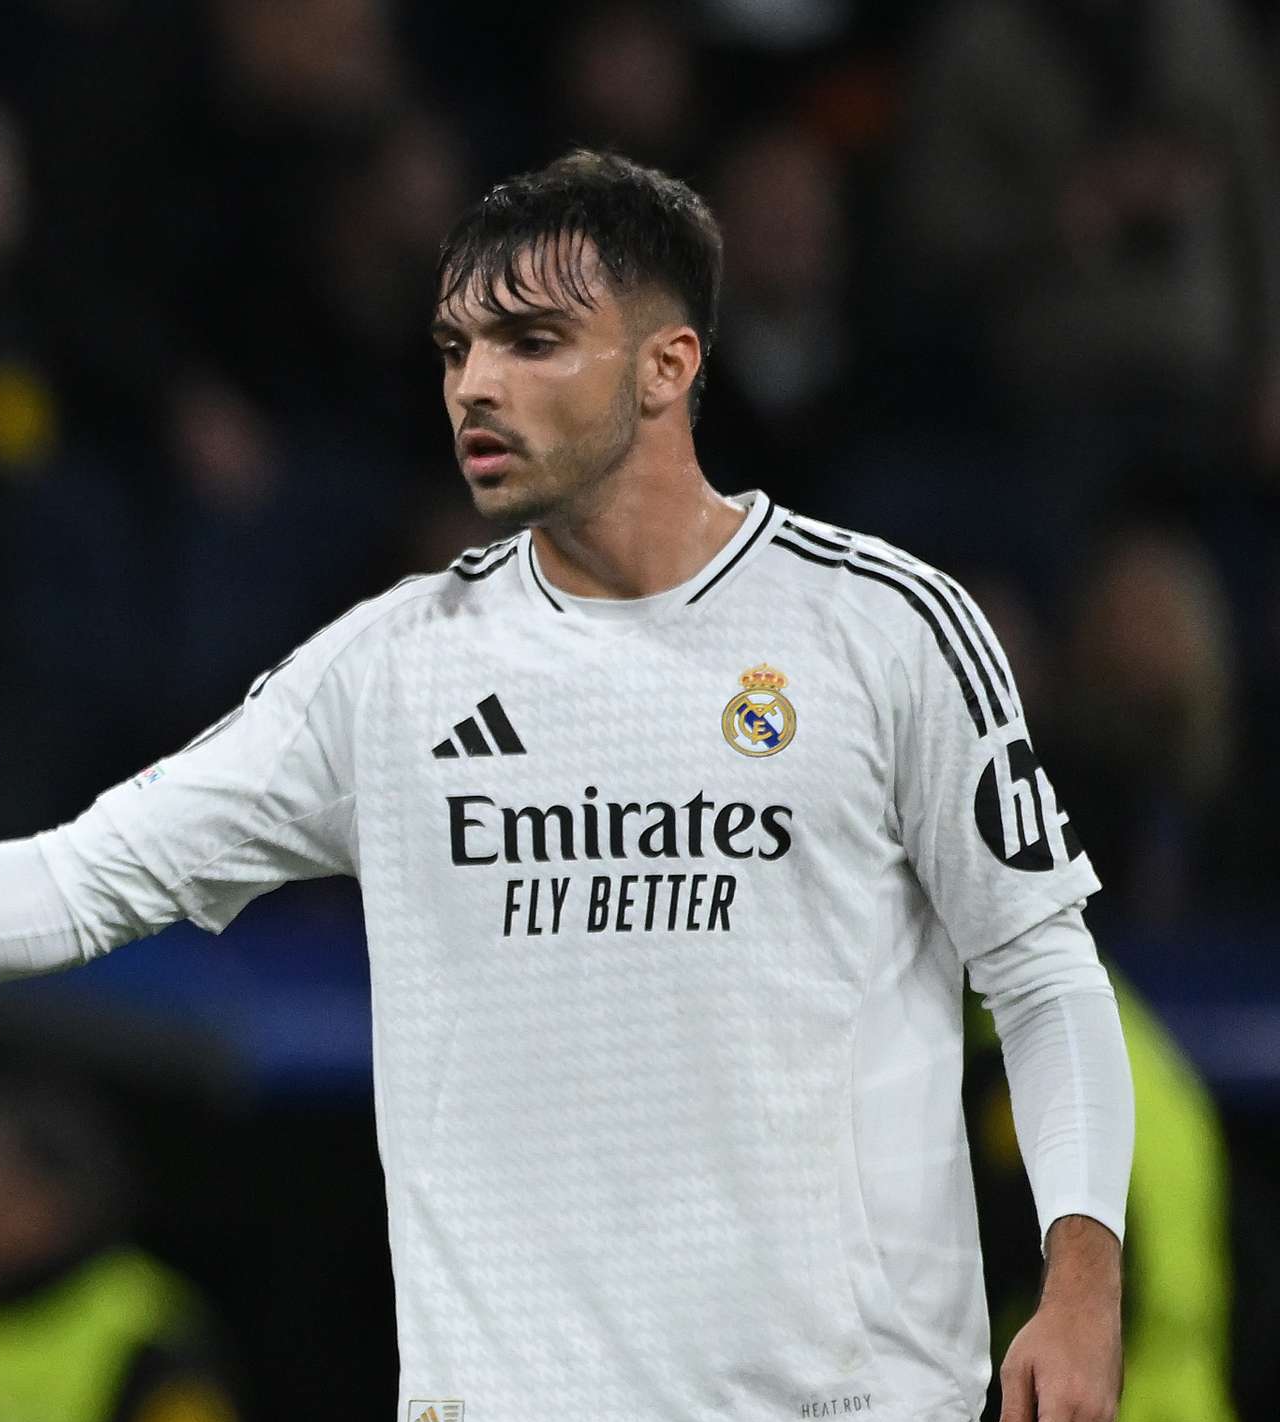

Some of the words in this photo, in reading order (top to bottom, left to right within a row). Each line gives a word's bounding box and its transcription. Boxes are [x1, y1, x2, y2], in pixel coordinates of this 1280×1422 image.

[445, 785, 793, 867] Emirates
[503, 876, 571, 937] FLY
[587, 873, 737, 935] BETTER
[801, 1393, 872, 1419] HEAT.RDY
